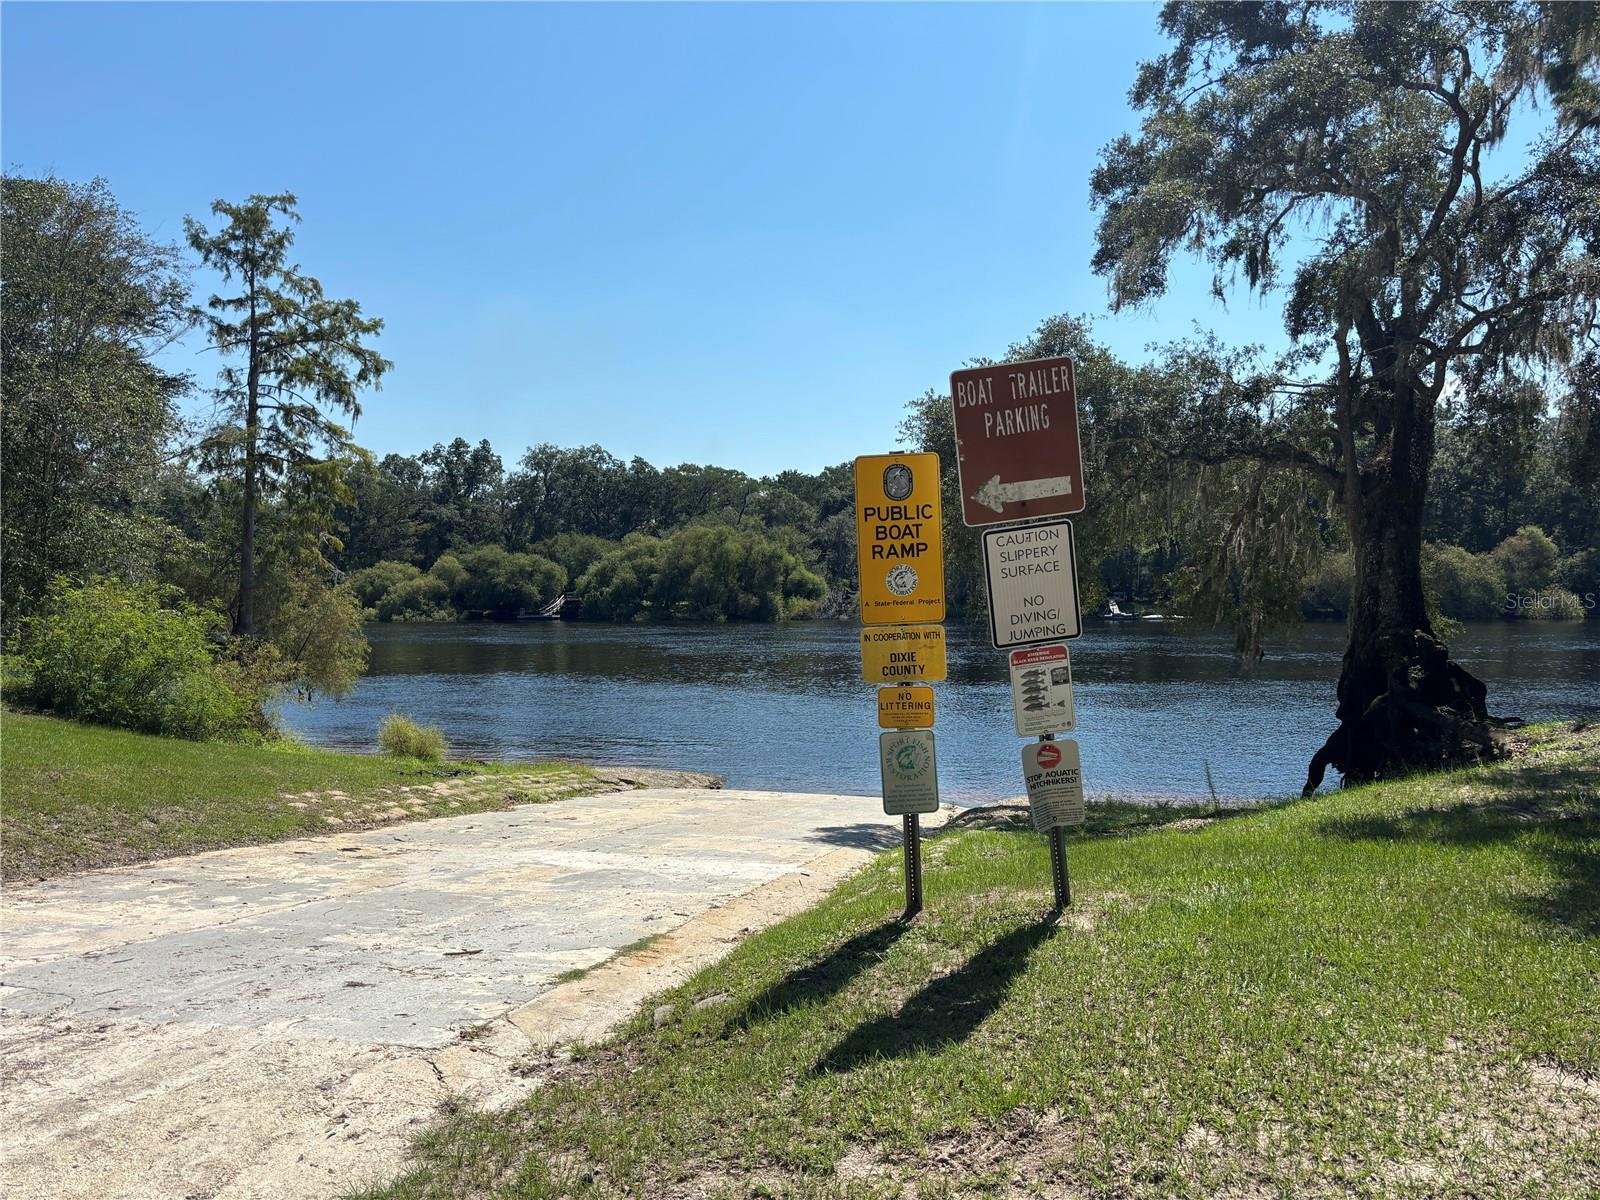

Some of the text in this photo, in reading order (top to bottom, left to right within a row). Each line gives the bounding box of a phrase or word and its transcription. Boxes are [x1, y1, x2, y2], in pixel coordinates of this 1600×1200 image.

[957, 366, 1071, 408] BOAT TRAILER
[984, 403, 1050, 438] PARKING
[864, 504, 933, 522] PUBLIC
[875, 523, 923, 540] BOAT
[996, 528, 1060, 547] CAUTION
[872, 542, 928, 560] RAMP
[1000, 544, 1059, 563] SLIPPERY
[1001, 560, 1061, 579] SURFACE
[918, 598, 941, 606] Project
[1023, 594, 1045, 607] NO
[1010, 607, 1061, 625] DIVING/
[864, 631, 941, 642] IN COOPERATION WITH
[1008, 623, 1067, 642] JUMPING
[890, 652, 917, 663] DIXIE
[882, 664, 925, 676] COUNTY
[898, 692, 912, 701] NO
[880, 701, 931, 711] LITTERING
[1026, 768, 1079, 784] STOP AQUATIC
[1029, 776, 1078, 791] HITCHHIKERS!
